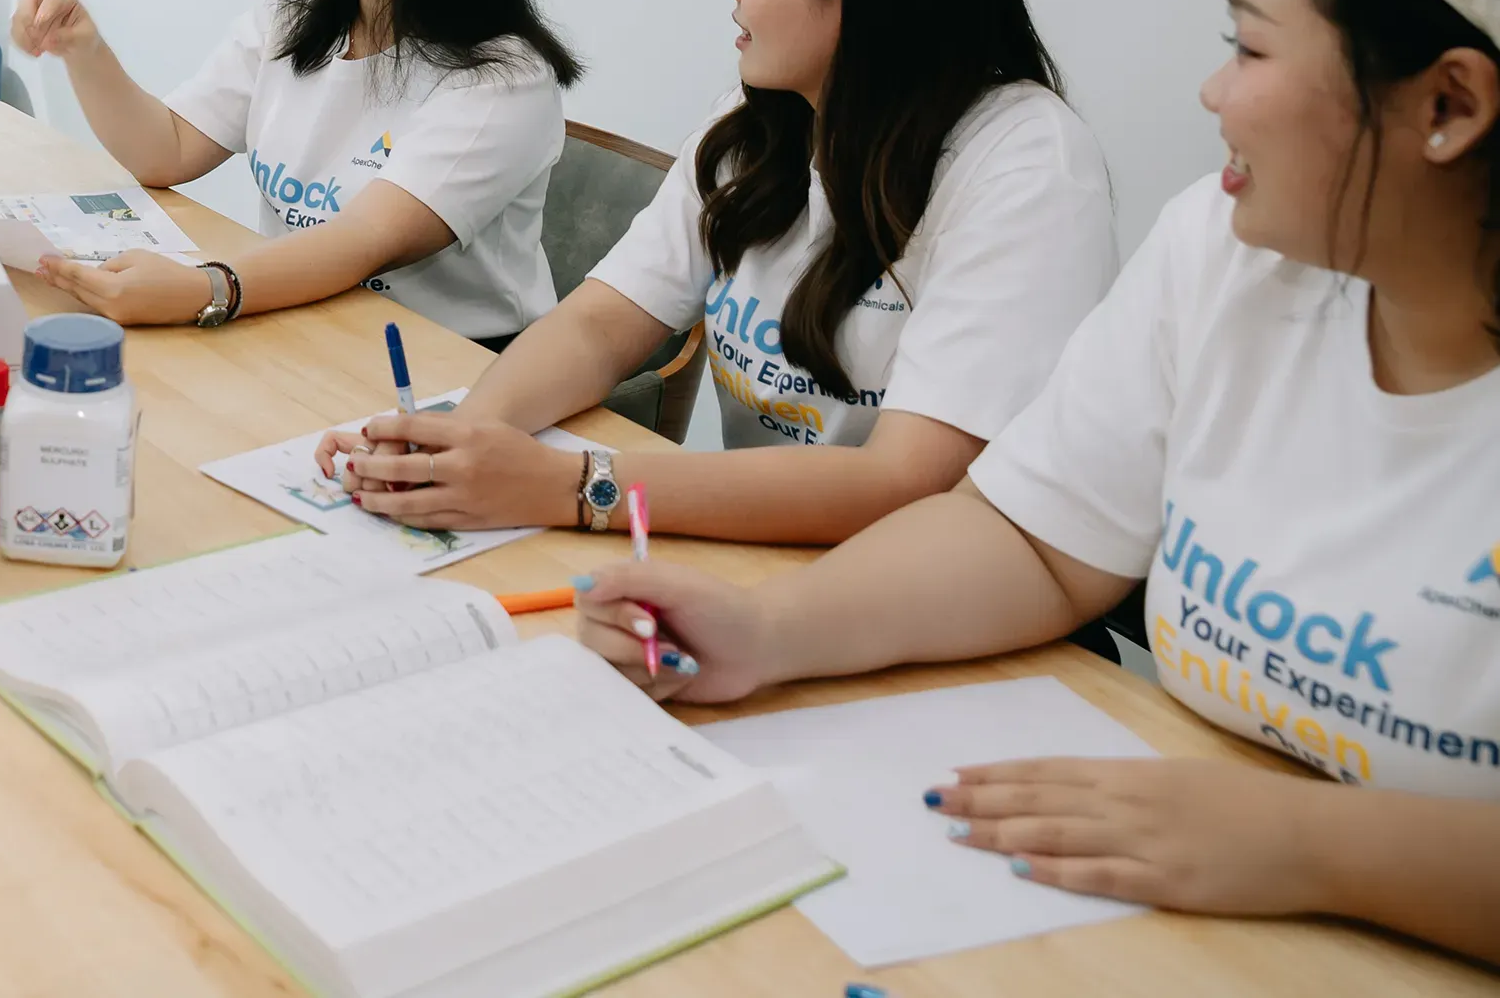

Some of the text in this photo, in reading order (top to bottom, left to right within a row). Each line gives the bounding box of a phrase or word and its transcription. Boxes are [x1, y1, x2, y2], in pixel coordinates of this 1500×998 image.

[713, 329, 754, 373] Your
[758, 413, 801, 441] Our
[1162, 498, 1399, 693] Unlock
[1155, 615, 1372, 782] Enliven
[1179, 594, 1252, 662] Your
[1263, 650, 1500, 769] Experimen
